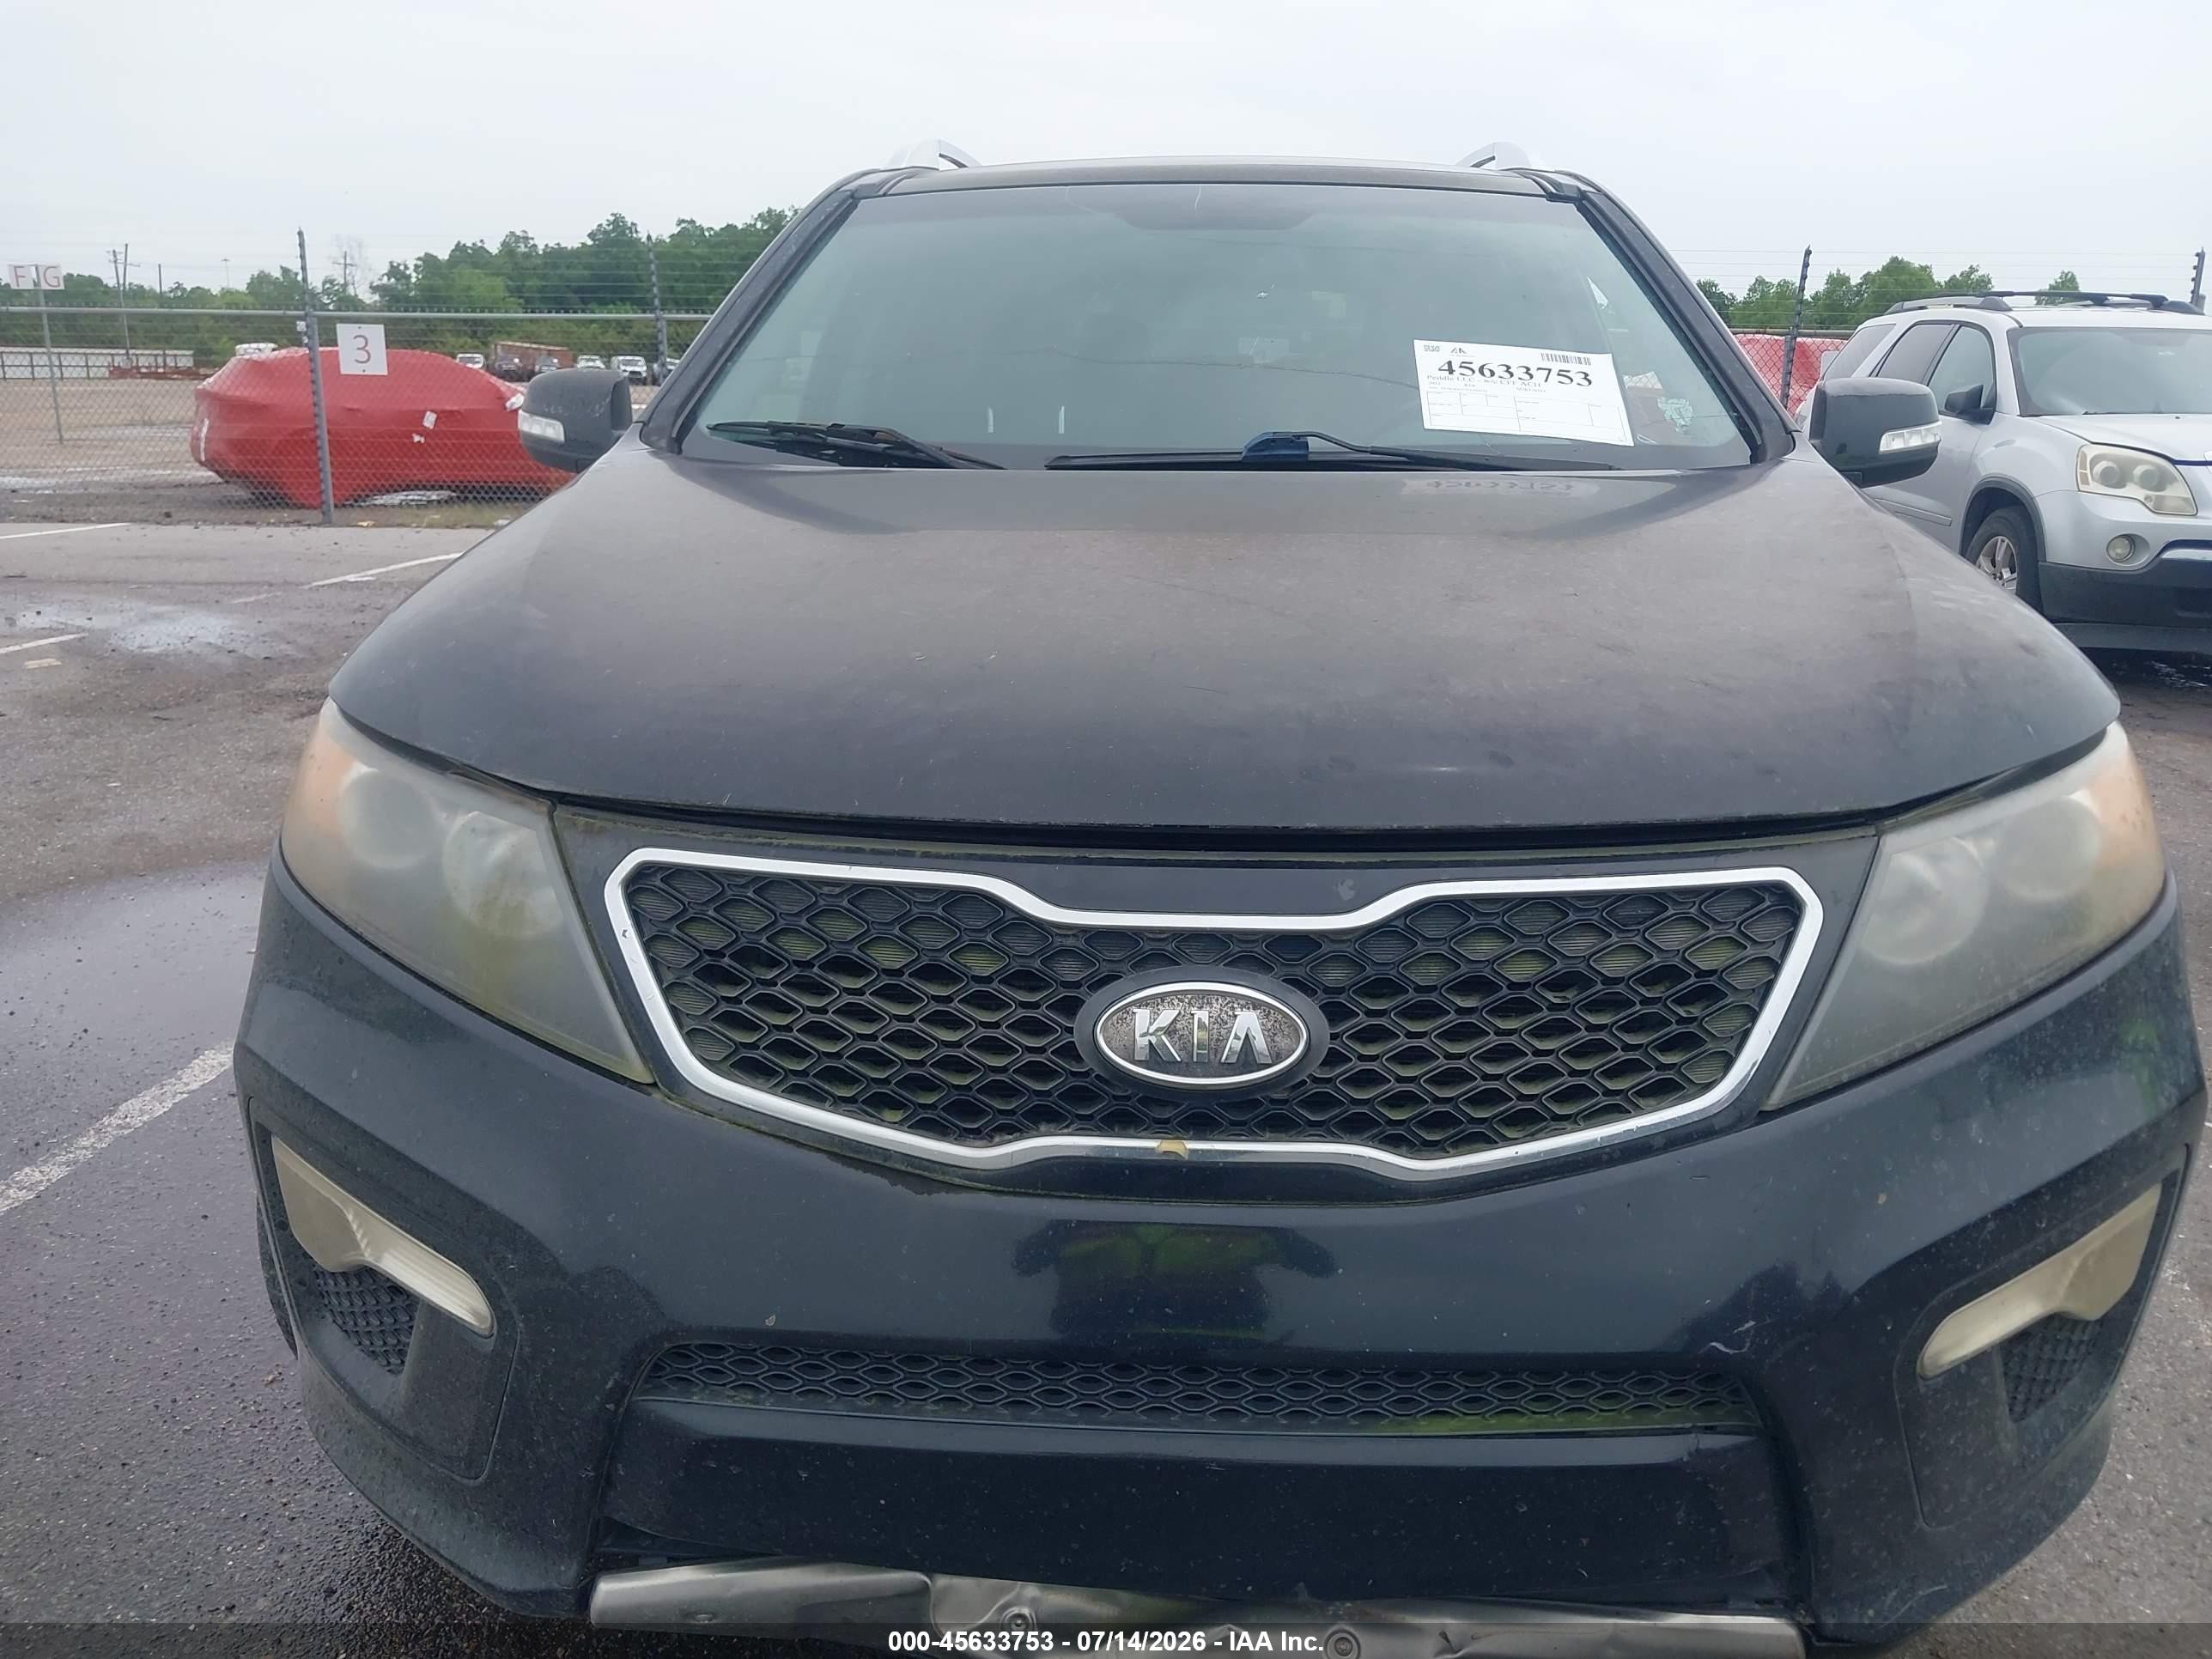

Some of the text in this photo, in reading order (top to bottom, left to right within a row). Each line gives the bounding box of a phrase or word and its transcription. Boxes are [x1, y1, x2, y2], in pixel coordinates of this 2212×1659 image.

[13, 265, 26, 288] F
[44, 266, 61, 288] G
[352, 334, 371, 364] 3
[1438, 360, 1593, 387] 45633753
[1133, 1008, 1272, 1064] KIA
